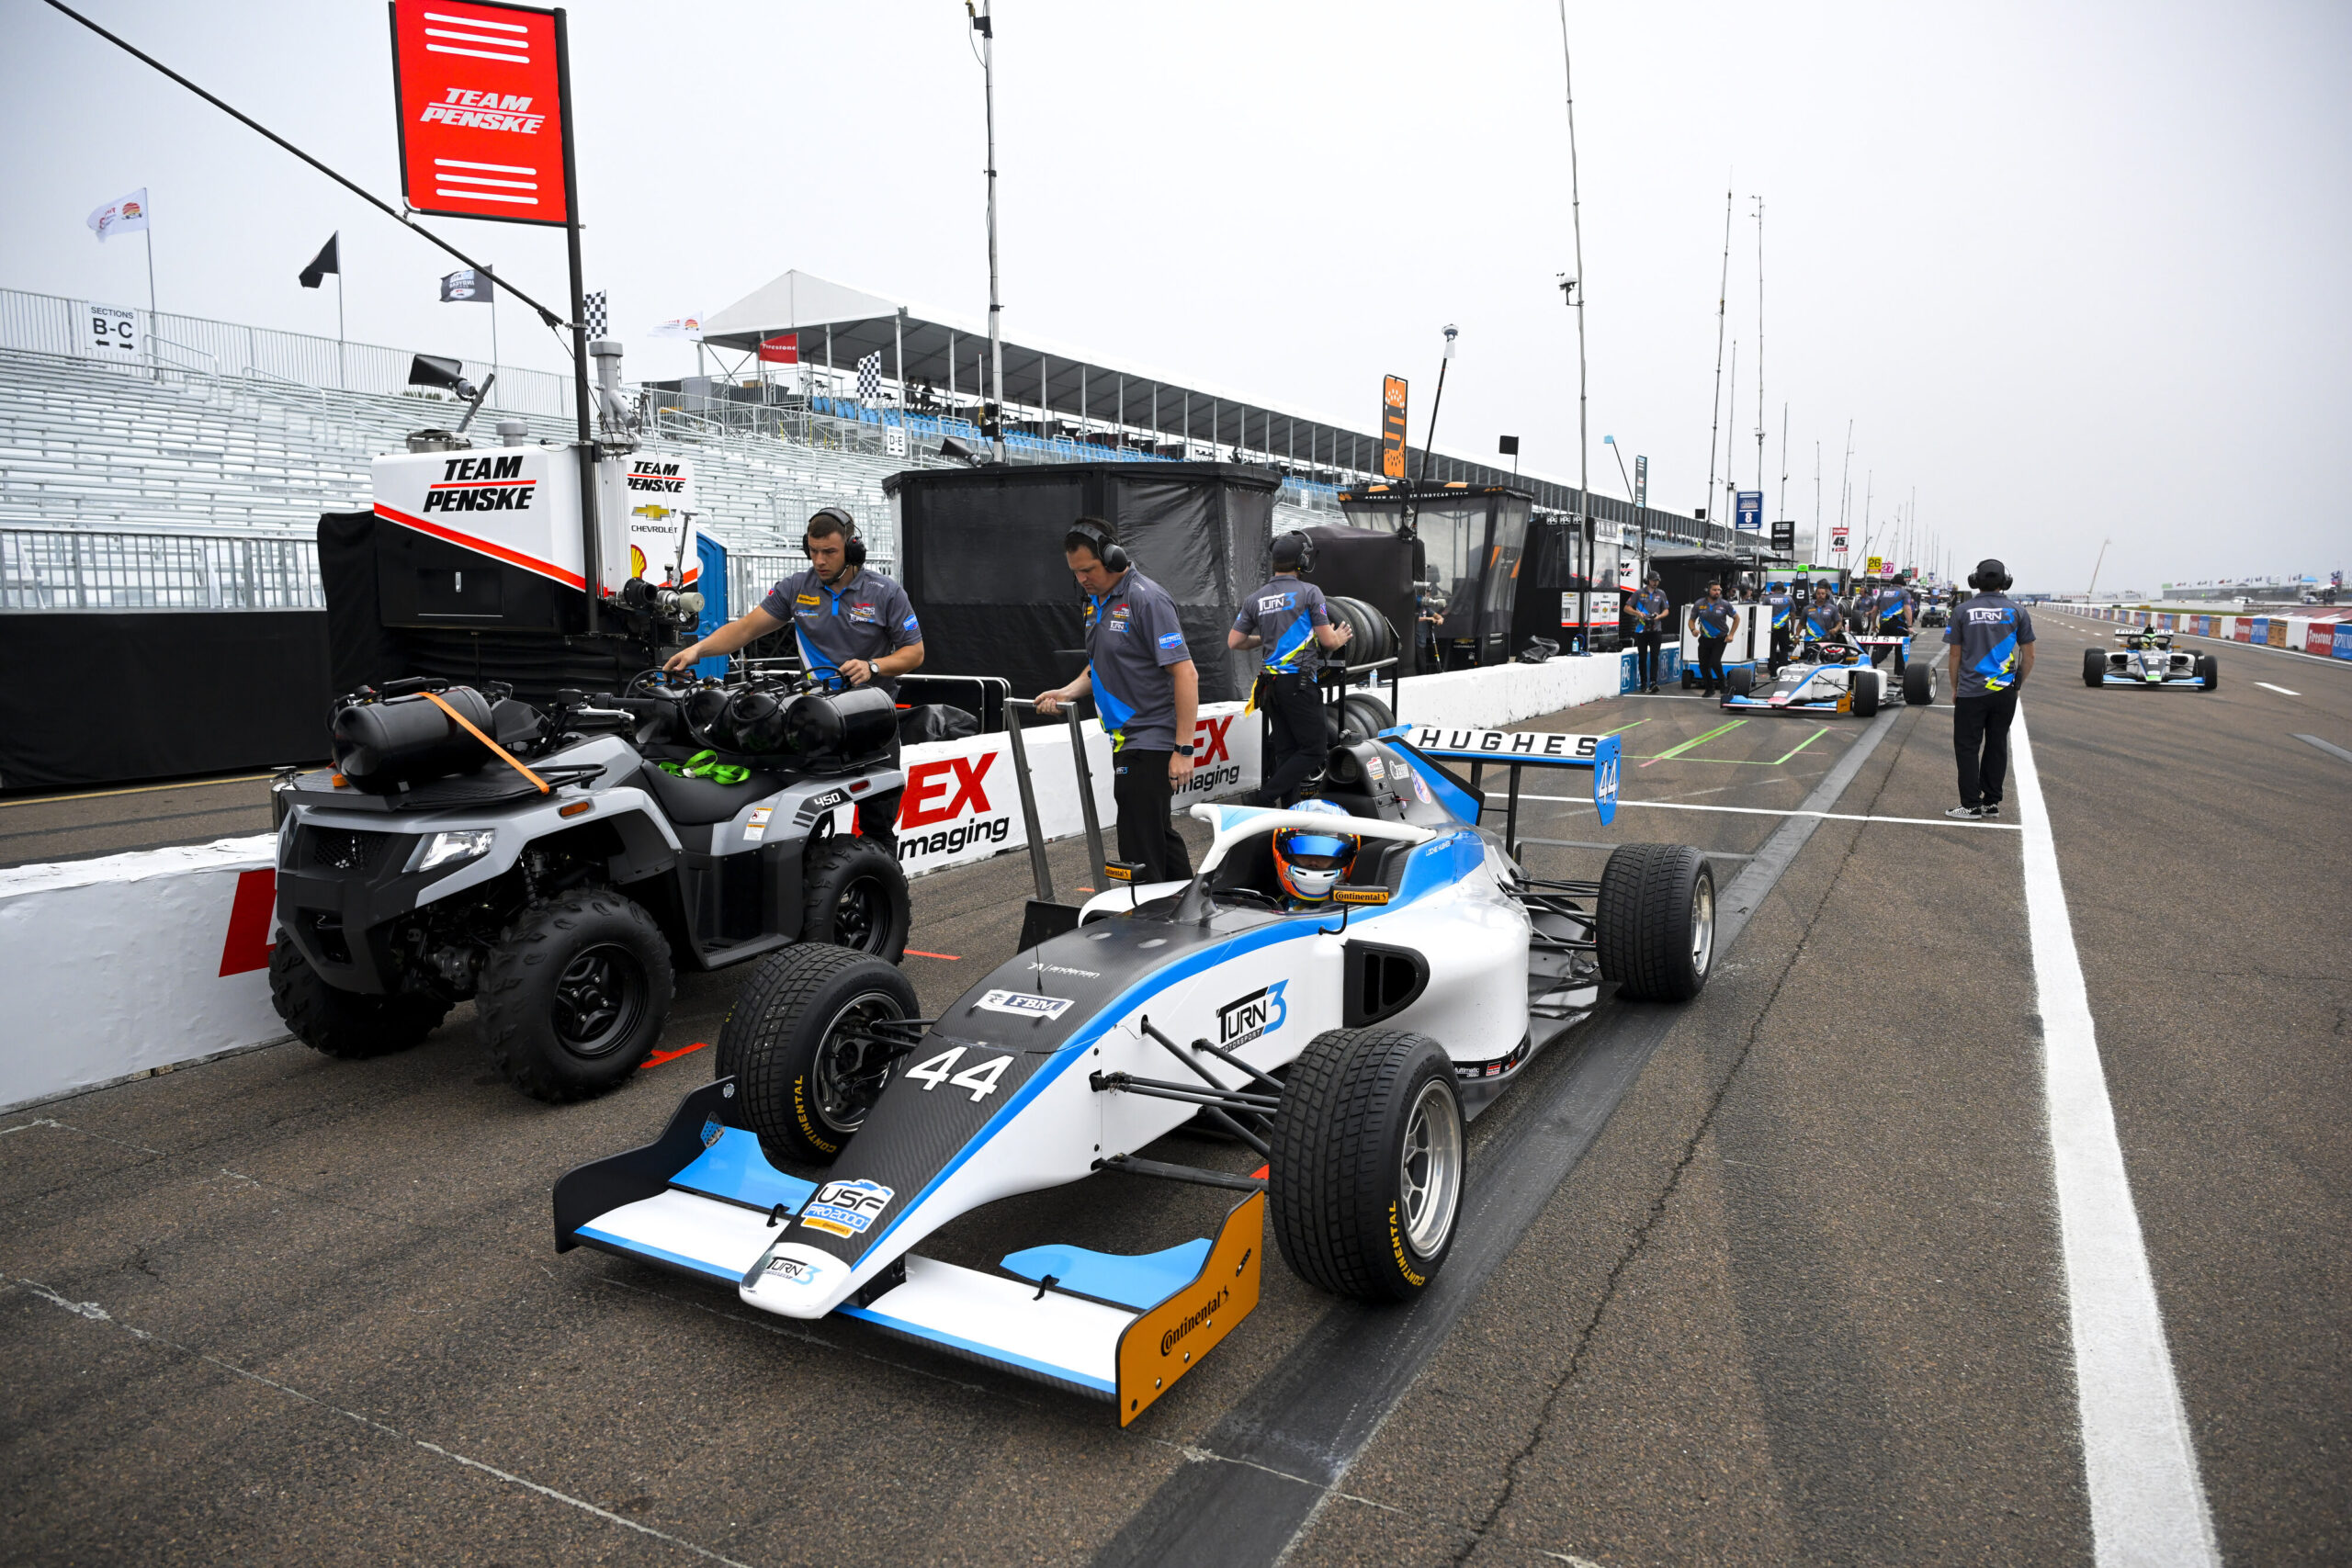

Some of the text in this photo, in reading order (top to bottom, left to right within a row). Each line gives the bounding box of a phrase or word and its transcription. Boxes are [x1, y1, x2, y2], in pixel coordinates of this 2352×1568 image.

[447, 87, 533, 112] TEAM
[420, 107, 544, 134] PENSKE
[91, 306, 134, 320] SECTIONS
[93, 318, 133, 339] B-C
[763, 343, 797, 351] Firestone
[444, 456, 524, 481] TEAM
[633, 460, 680, 476] TEAM
[423, 487, 535, 513] PENSKE
[631, 525, 678, 535] CHEVROLET
[1573, 515, 1581, 524] PP
[1833, 536, 1845, 547] 45
[1868, 558, 1881, 568] 26
[1882, 564, 1894, 573] 27
[2308, 629, 2332, 646] Firestone
[1193, 715, 1234, 768] EX
[1418, 728, 1599, 756] HUGHES
[1598, 756, 1618, 805] 44
[814, 792, 841, 807] 450
[1335, 890, 1381, 901] Continental
[1010, 996, 1061, 1011] FBM
[904, 1045, 1015, 1102] 44
[795, 1074, 838, 1154] CONTINENTAL
[817, 1185, 885, 1212] USF
[1389, 1200, 1425, 1287] CONTINENTAL
[1160, 1291, 1221, 1358] Continental
